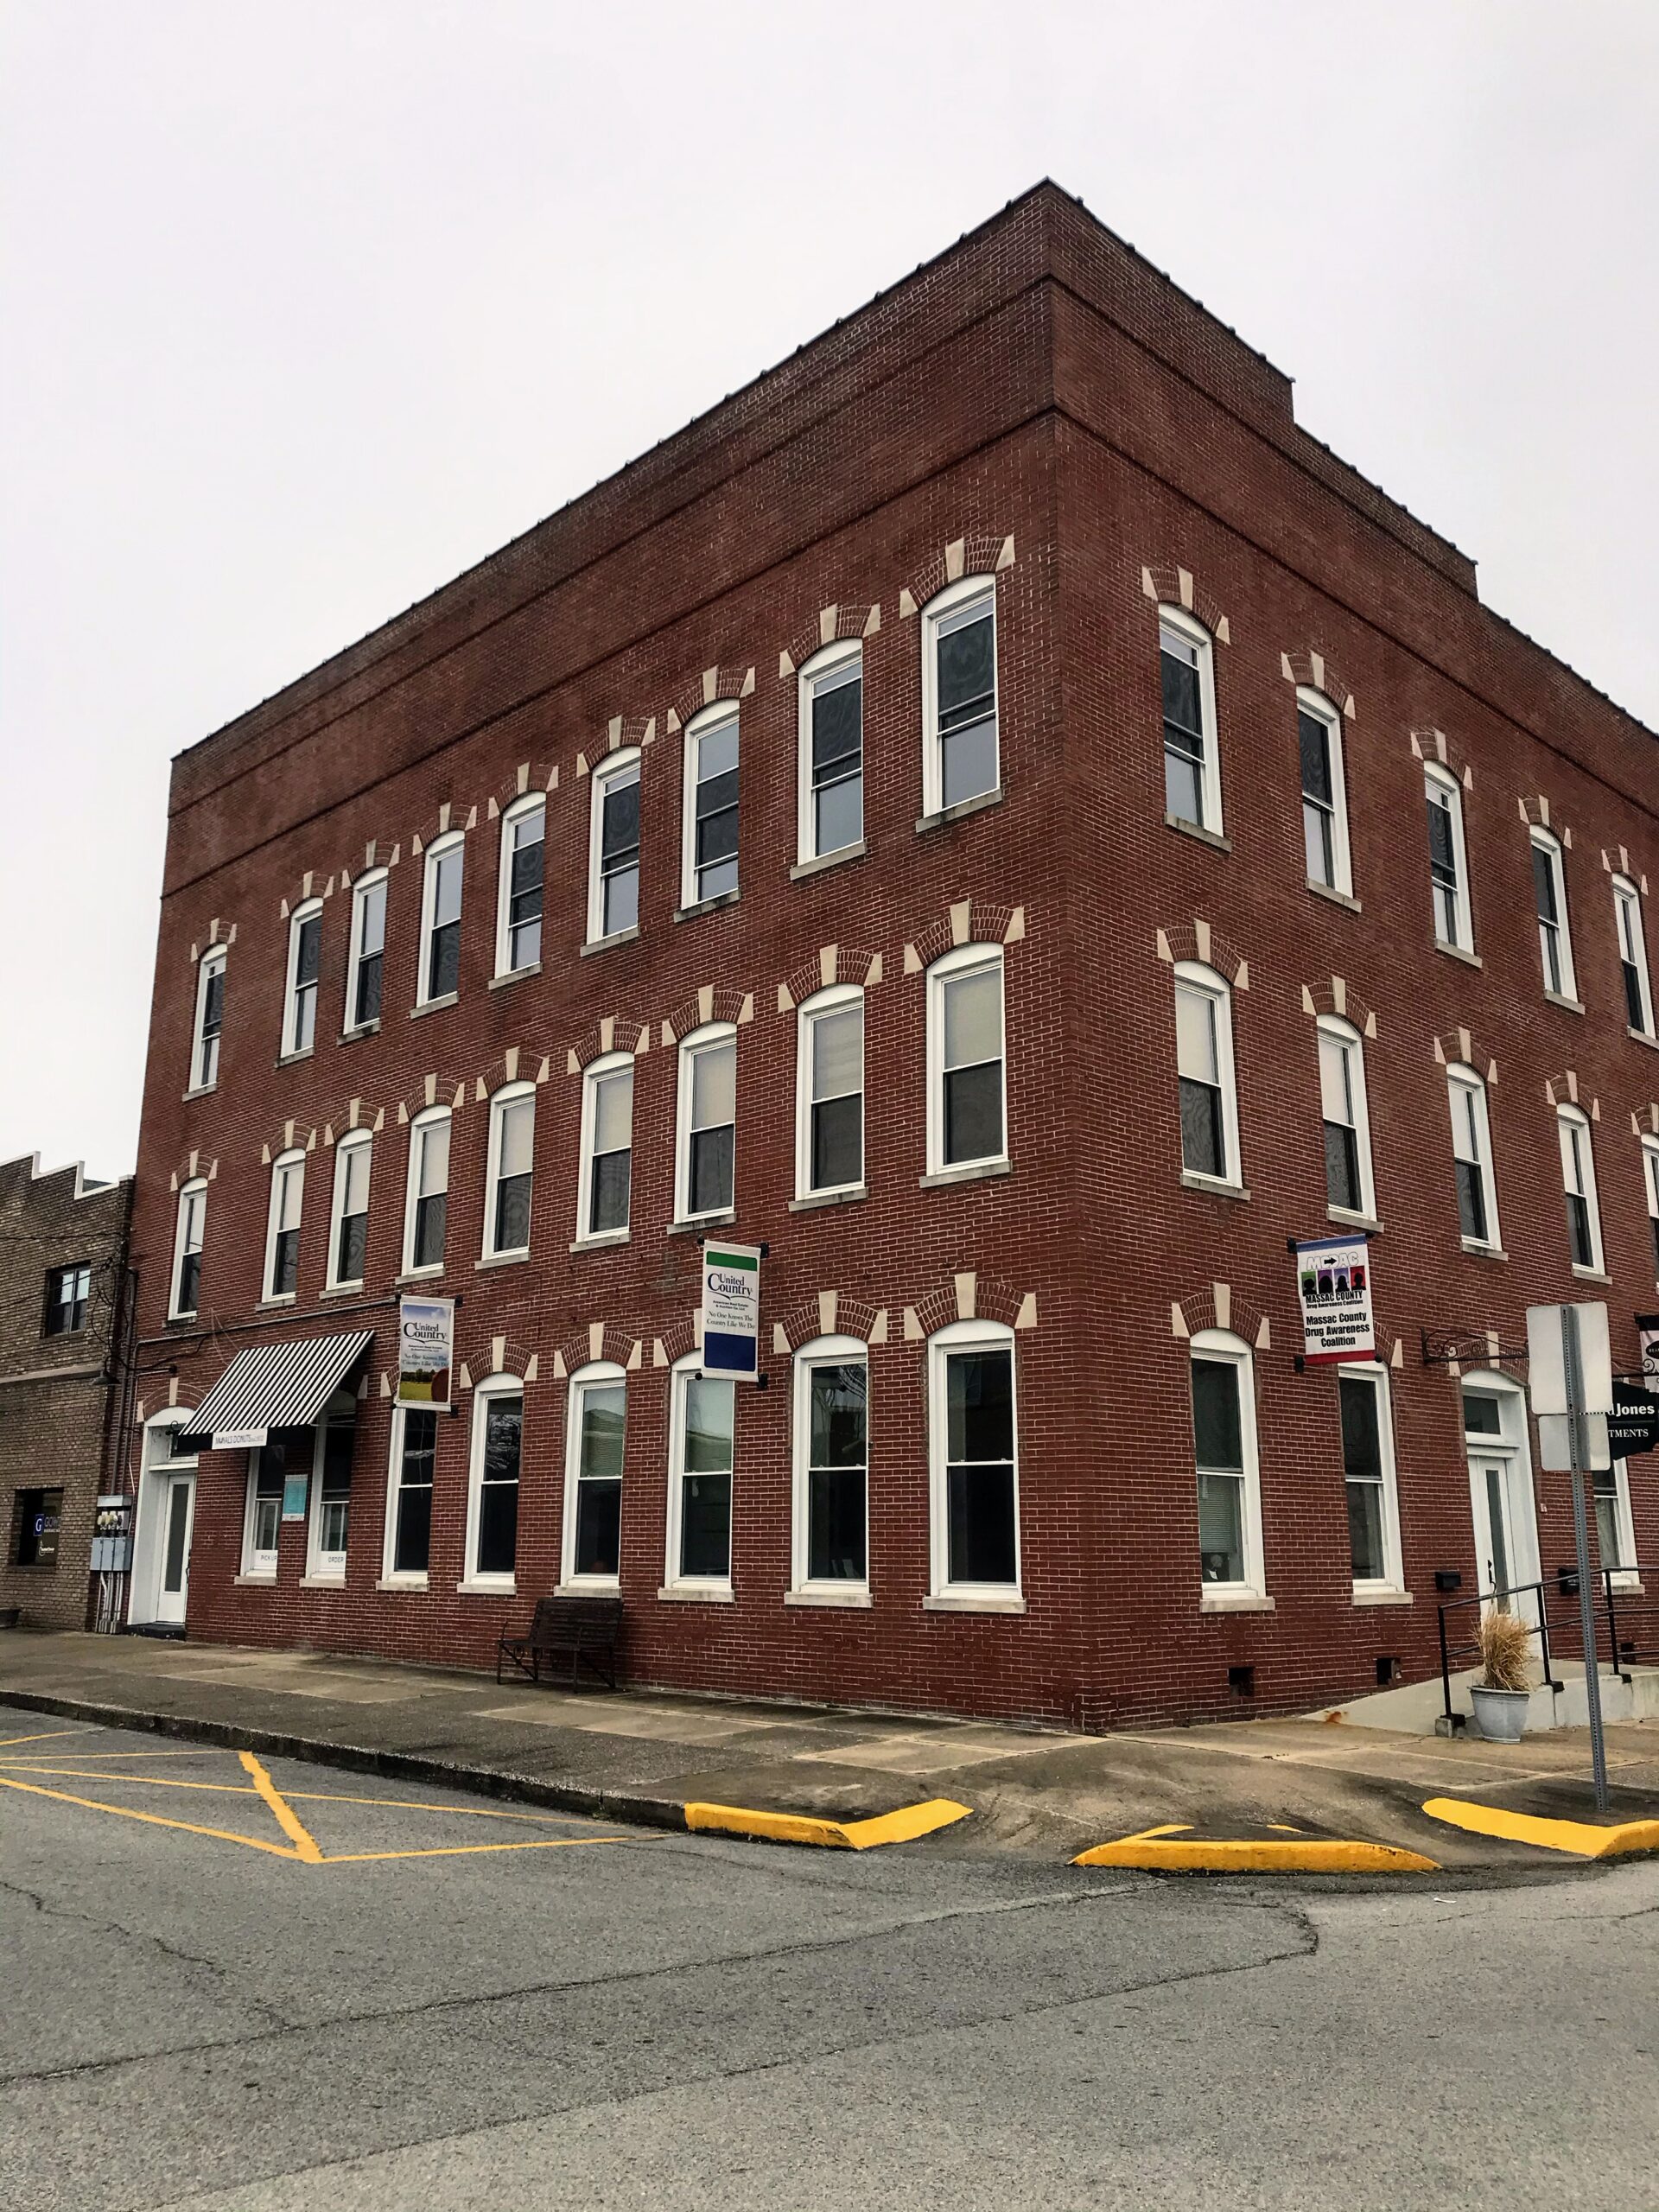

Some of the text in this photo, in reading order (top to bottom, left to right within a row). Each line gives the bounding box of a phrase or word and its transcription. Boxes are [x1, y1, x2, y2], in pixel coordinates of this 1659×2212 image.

[707, 1273, 751, 1296] Country
[719, 1274, 744, 1286] United
[1306, 1290, 1363, 1304] MASSAC COUNTY
[707, 1318, 726, 1327] Country
[1306, 1313, 1367, 1325] Massac County
[404, 1322, 445, 1339] Country
[415, 1322, 439, 1332] United
[1305, 1324, 1370, 1337] Drug Awareness
[1321, 1336, 1356, 1347] Coalition
[1608, 1428, 1649, 1438] TMENTS
